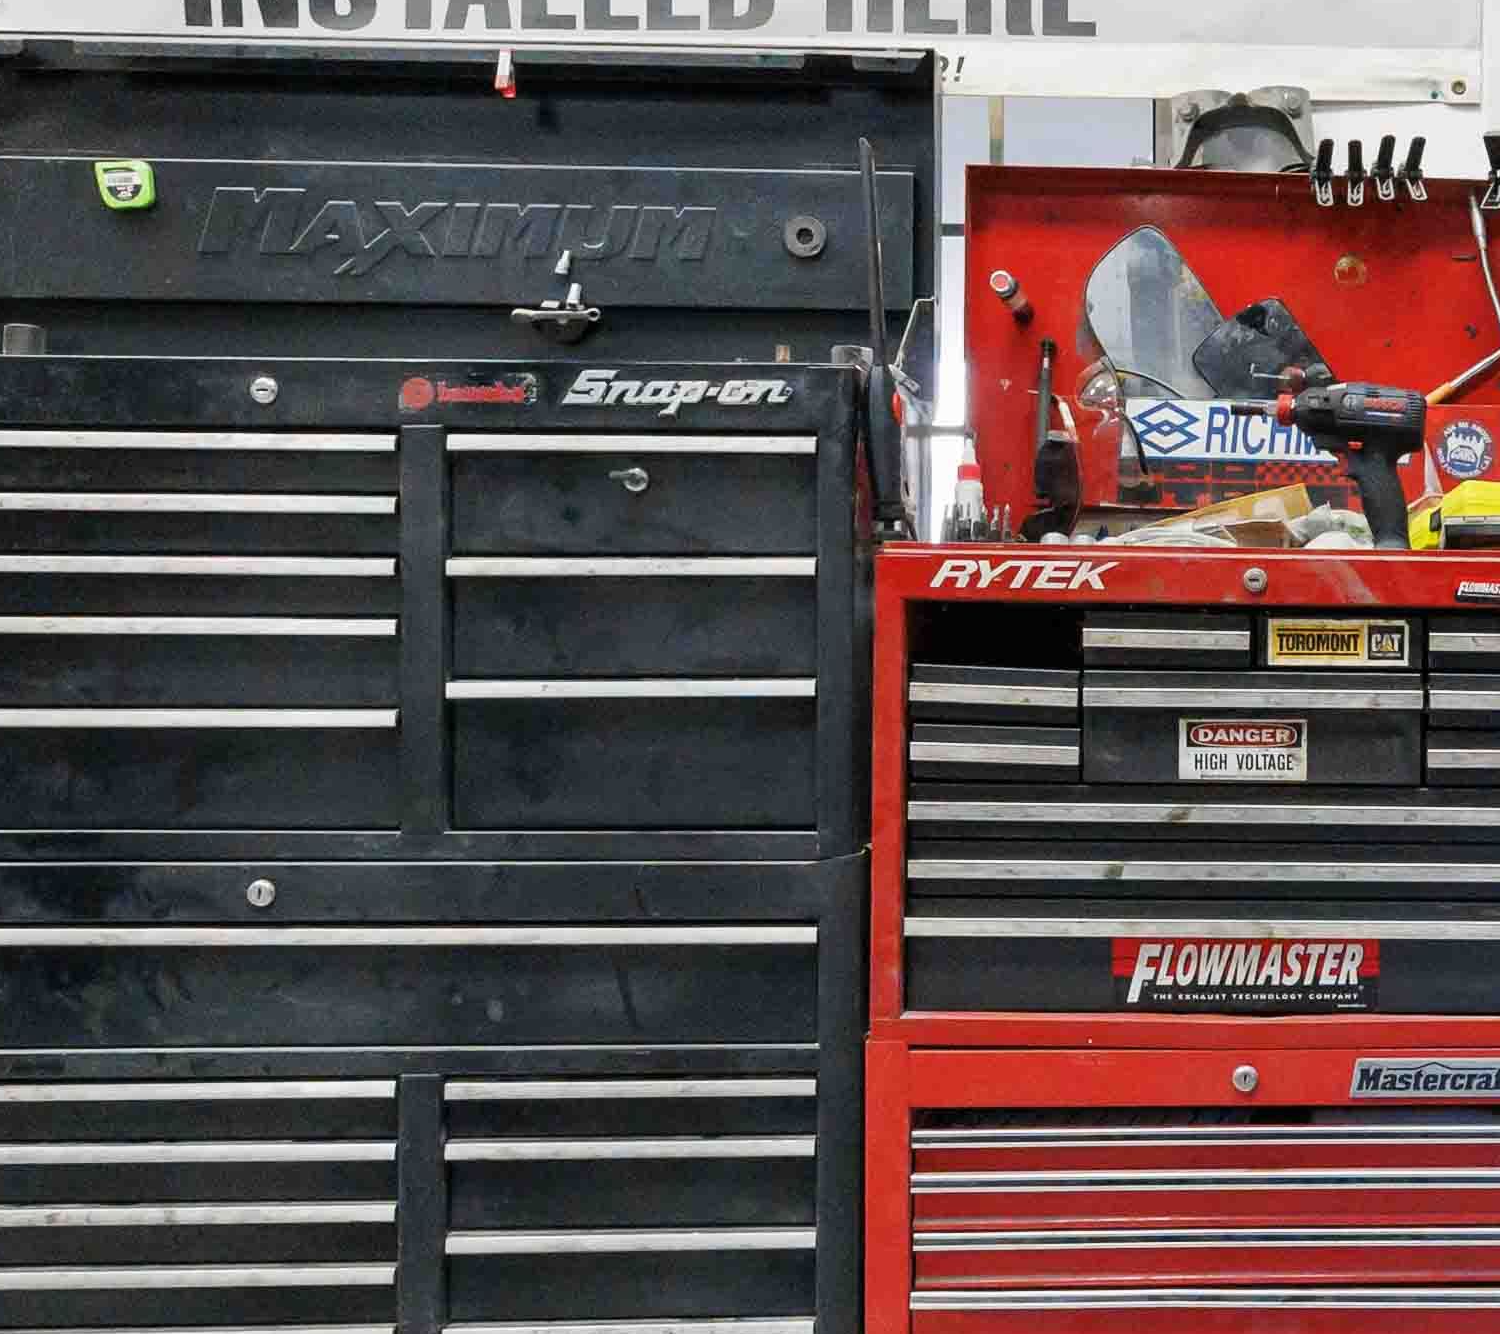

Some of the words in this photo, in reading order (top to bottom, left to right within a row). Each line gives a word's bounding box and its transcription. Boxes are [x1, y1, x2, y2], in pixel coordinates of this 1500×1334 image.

[200, 186, 717, 276] MAXIMUM
[562, 369, 792, 416] Snap-on
[929, 558, 1121, 590] RYTEK
[1276, 632, 1360, 653] TOROMONT
[1371, 632, 1401, 653] CAT
[1198, 728, 1291, 743] DANGER
[1194, 753, 1228, 771] HIGH
[1235, 753, 1294, 771] VOLTAGE
[1126, 943, 1365, 1004] FLOWMASTER
